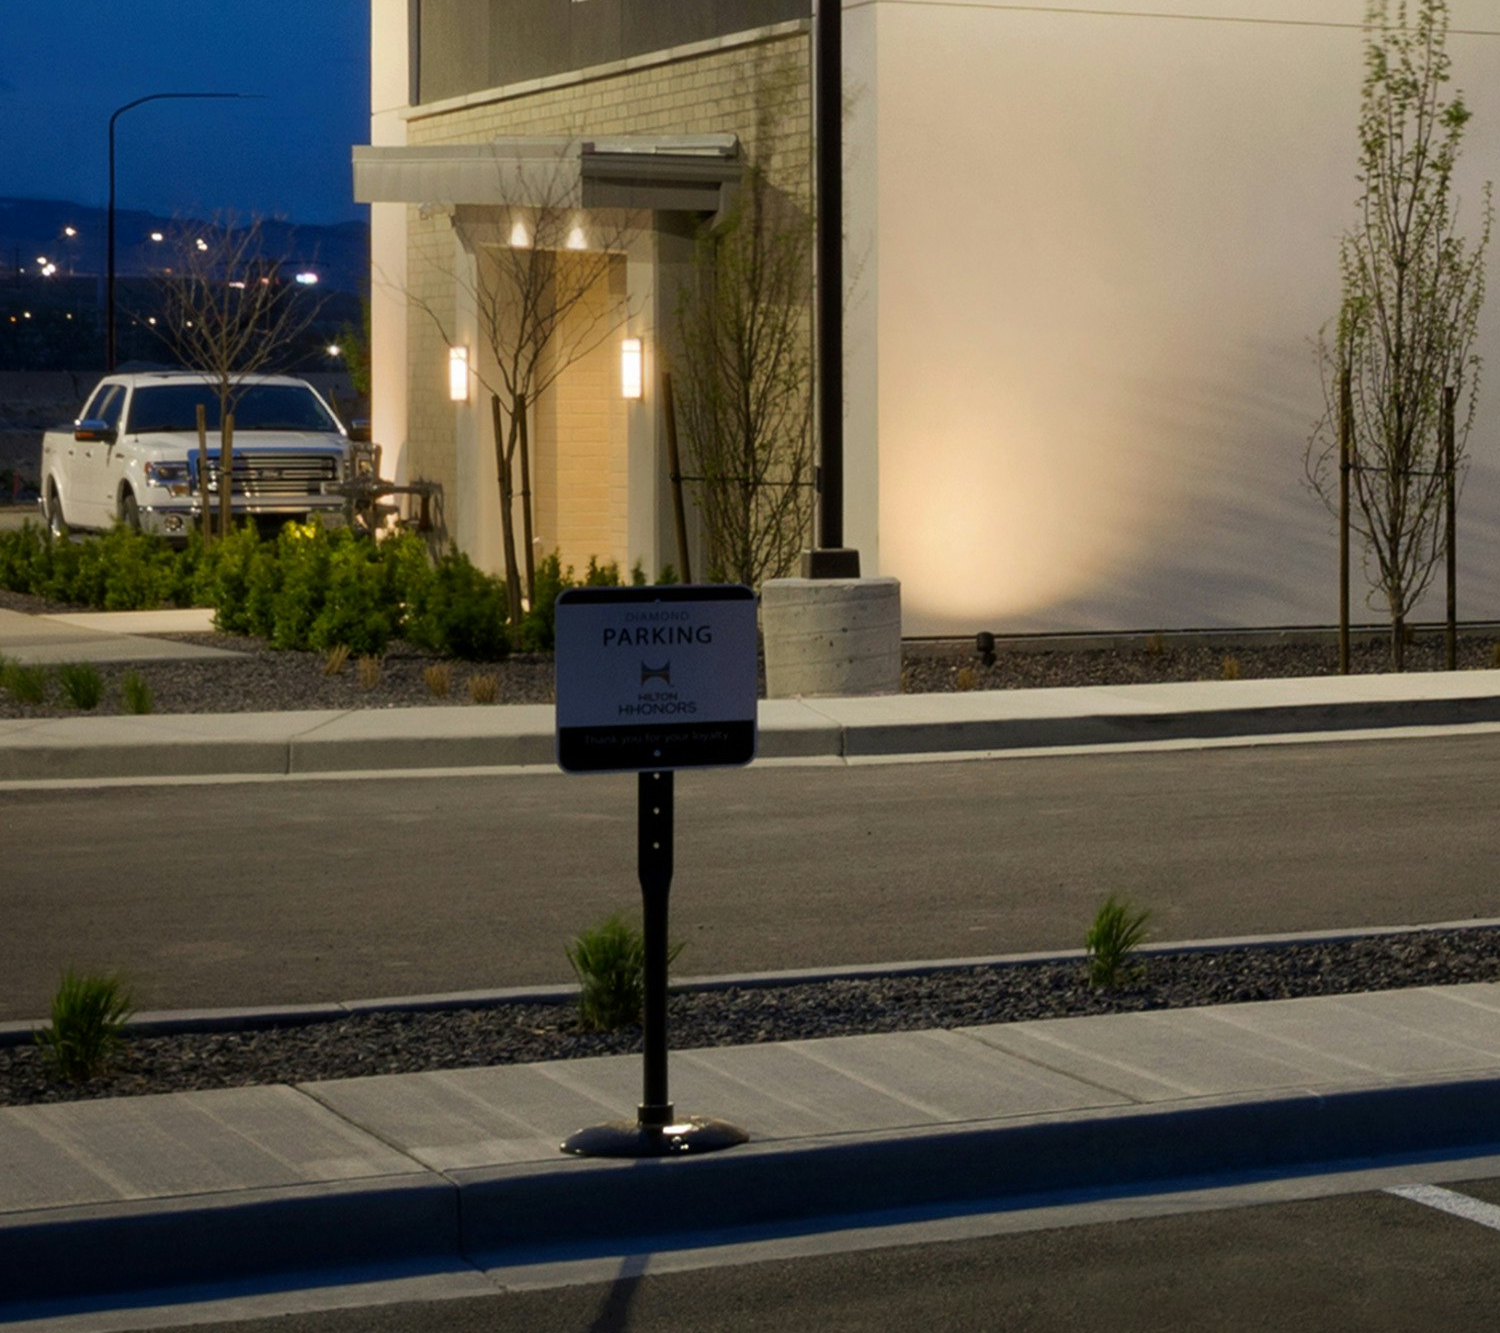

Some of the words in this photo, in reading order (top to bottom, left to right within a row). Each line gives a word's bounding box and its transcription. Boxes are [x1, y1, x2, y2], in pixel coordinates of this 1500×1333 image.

[625, 610, 690, 622] DIAMOND
[603, 625, 713, 647] PARKING
[637, 692, 678, 702] HILTON
[618, 701, 697, 716] HHONORS
